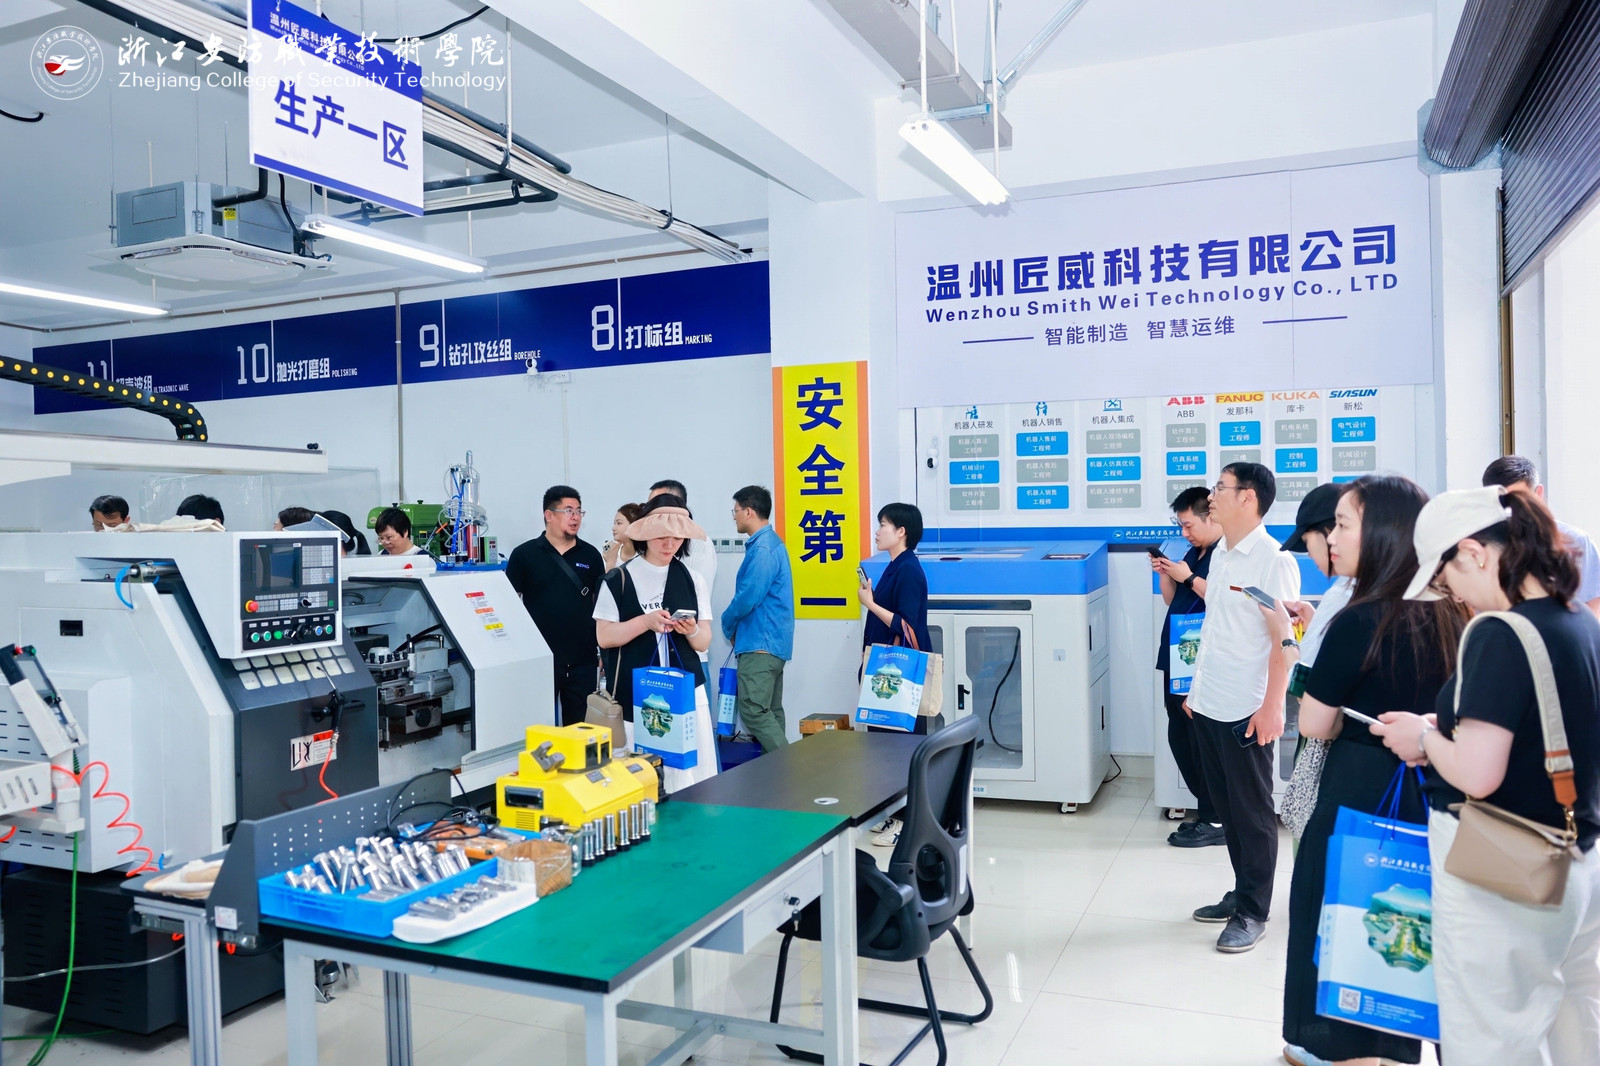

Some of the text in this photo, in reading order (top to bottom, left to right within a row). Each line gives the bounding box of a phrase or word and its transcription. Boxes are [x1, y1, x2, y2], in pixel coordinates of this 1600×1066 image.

[275, 80, 408, 170] 生产一区
[926, 224, 1397, 301] 温州匠威科技有限公司
[926, 273, 1399, 323] Wenzhou Smith Wei Technology Co., LTD
[591, 304, 614, 352] 8
[1045, 315, 1236, 346] 智能制造 智慧运维
[625, 321, 683, 350] 打标组
[684, 333, 712, 345] MARKING
[419, 323, 440, 368] 9
[448, 338, 512, 366] 钻孔攻丝组
[514, 349, 541, 360] BOREHOLE
[237, 343, 269, 385] 10
[276, 357, 330, 382] 抛光打磨组
[331, 367, 358, 378] POLISHING
[1216, 393, 1264, 403] FANUC
[1271, 391, 1320, 401] KUKA
[1328, 388, 1378, 398] SIASUN
[1167, 396, 1205, 406] ABB
[1343, 401, 1363, 411] 新松
[1176, 409, 1195, 418] ABB
[1226, 406, 1254, 416] 发那科
[1286, 404, 1305, 413] 库卡
[954, 420, 994, 430] 机器人研发
[1021, 417, 1063, 428] 机器人销售
[1092, 414, 1135, 425] 机器人集成
[1233, 425, 1247, 433] 工艺
[1229, 434, 1250, 442] 工程师
[796, 377, 847, 606] 安全第一
